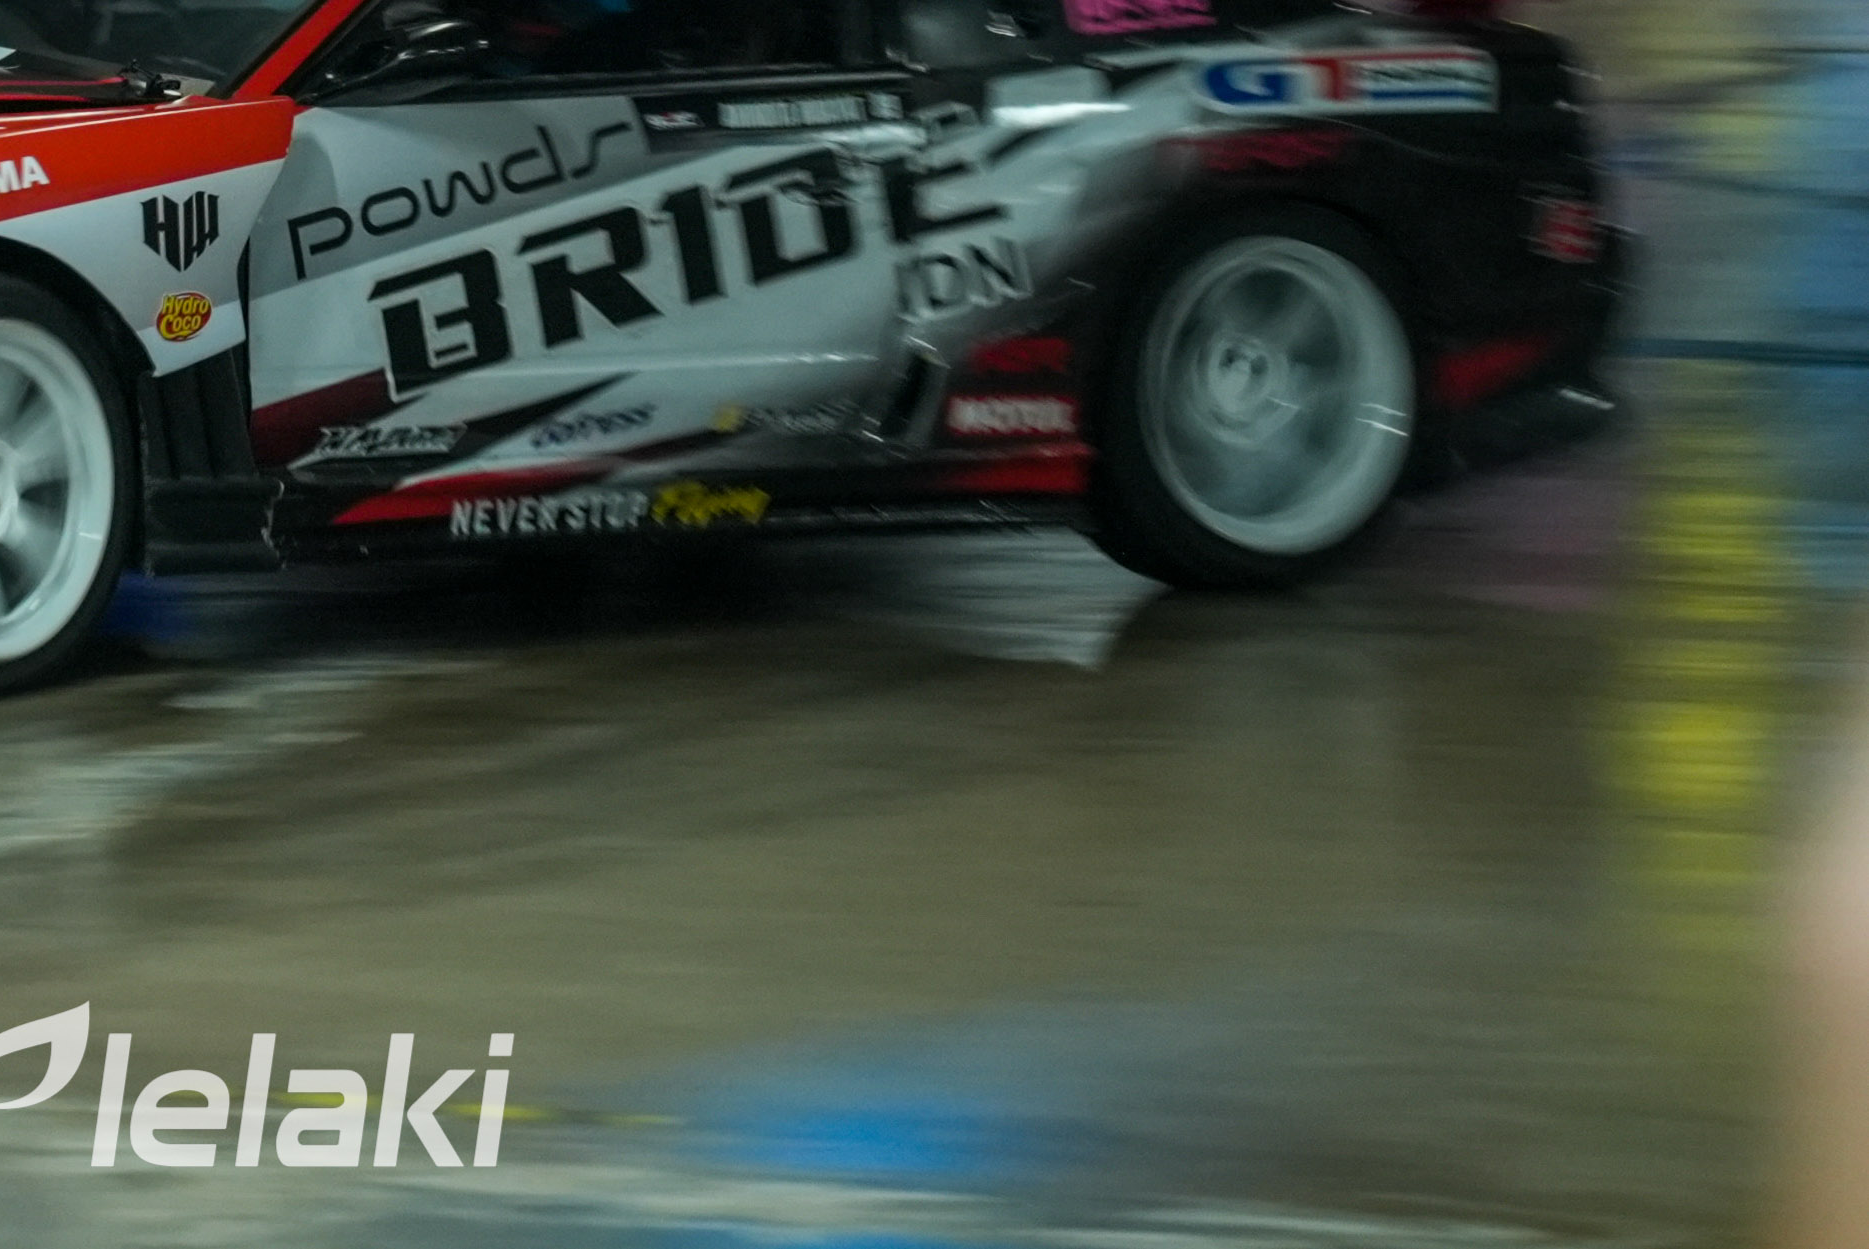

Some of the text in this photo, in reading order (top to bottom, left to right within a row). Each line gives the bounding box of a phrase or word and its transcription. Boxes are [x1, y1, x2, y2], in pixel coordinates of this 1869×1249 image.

[365, 104, 1013, 399] BRIDE
[162, 294, 209, 314] Hydro
[160, 314, 202, 339] Coco
[449, 497, 559, 537] NEVER
